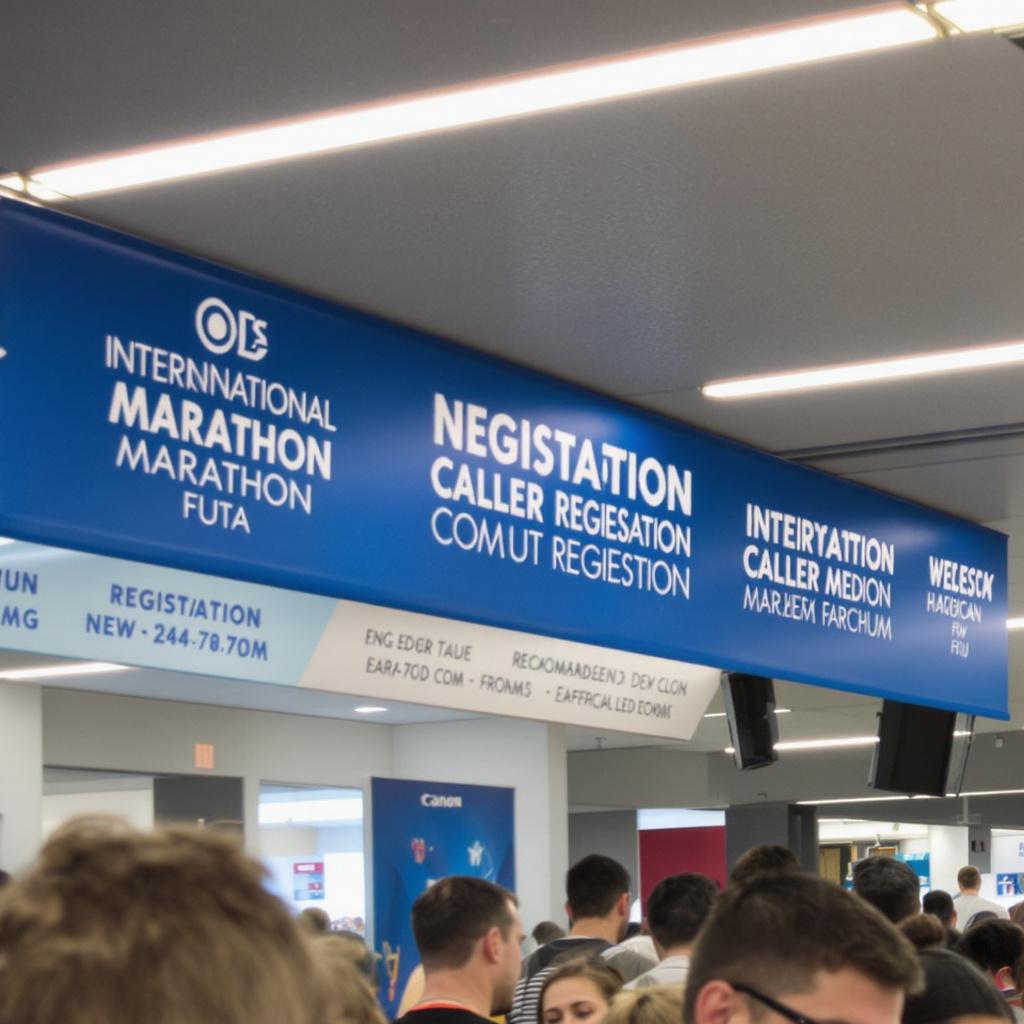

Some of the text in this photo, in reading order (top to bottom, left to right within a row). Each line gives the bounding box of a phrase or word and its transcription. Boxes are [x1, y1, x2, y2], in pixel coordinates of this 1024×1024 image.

[108, 381, 331, 481] MARATHON
[115, 435, 311, 515] MARATHON
[430, 456, 544, 523] CALLER
[182, 491, 250, 534] FUTA
[431, 506, 543, 565] COMUT
[0, 568, 38, 595] UN
[743, 544, 891, 609] CALLER MEDION
[86, 612, 136, 639] NEW
[434, 668, 464, 687] COM
